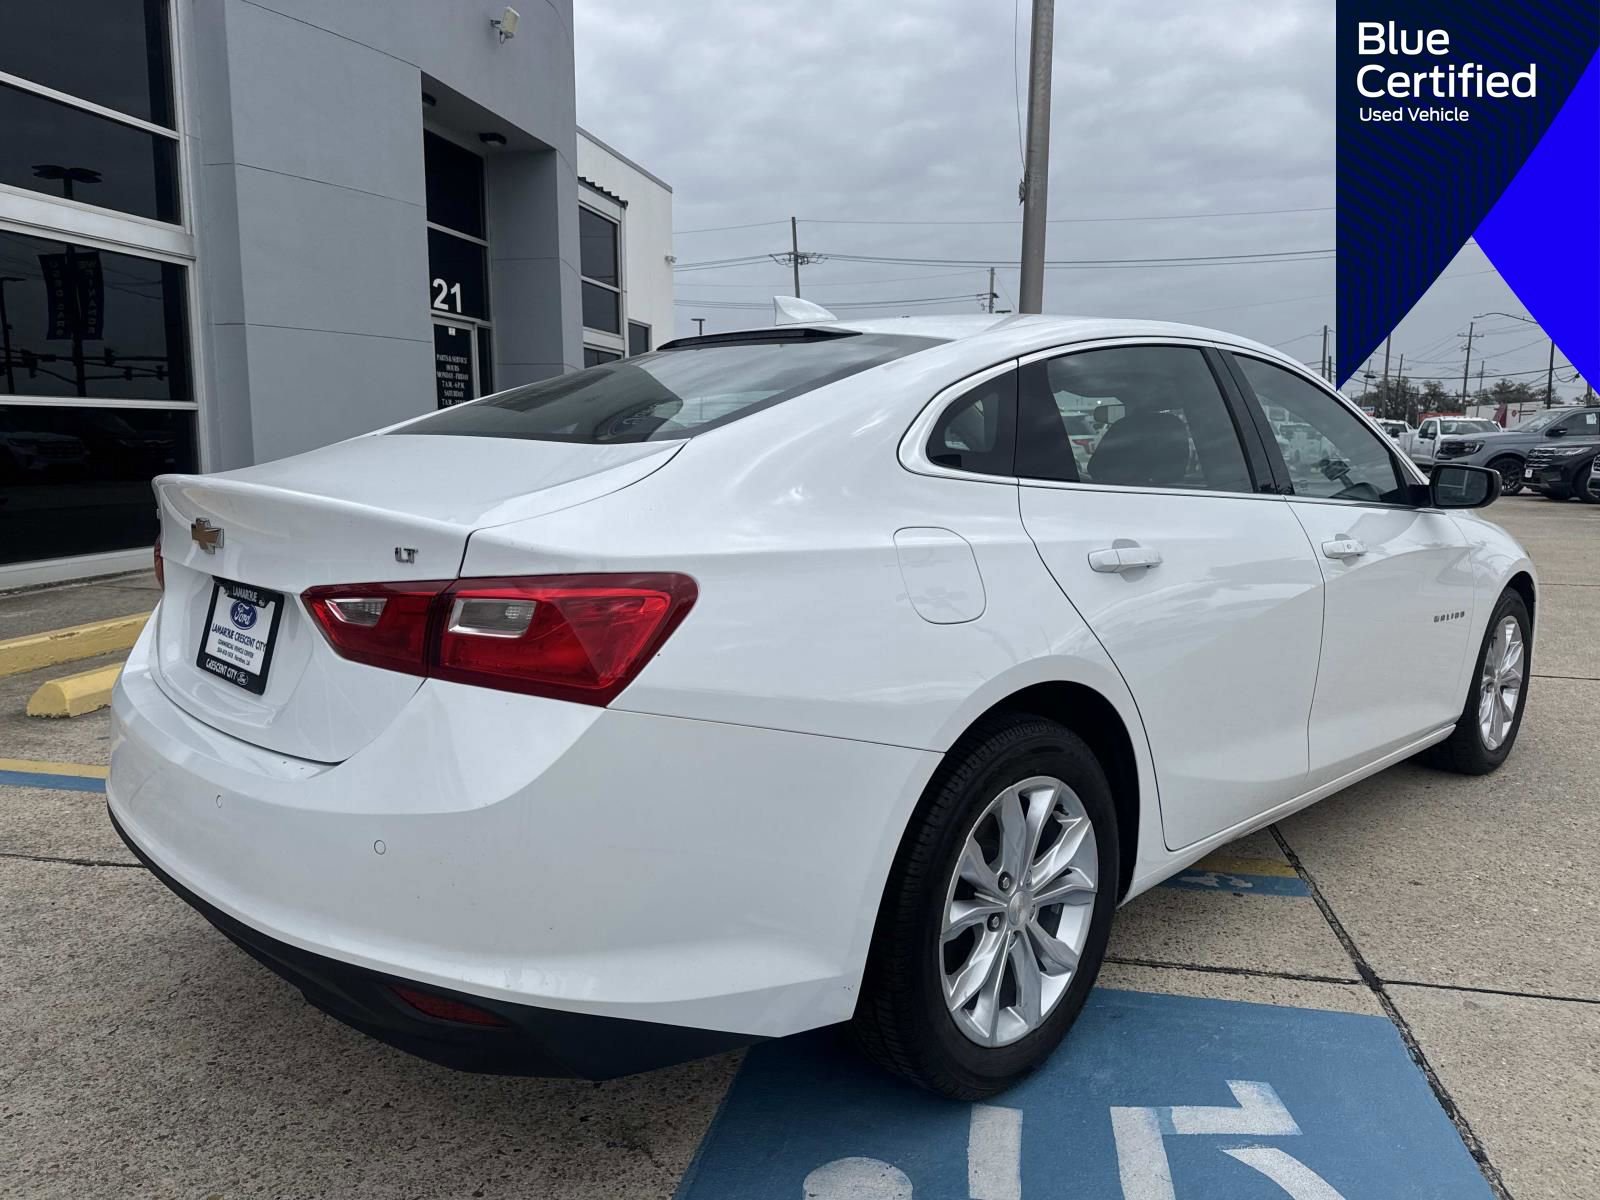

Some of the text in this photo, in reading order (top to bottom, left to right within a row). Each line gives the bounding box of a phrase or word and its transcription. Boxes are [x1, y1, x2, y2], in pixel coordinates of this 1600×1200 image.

[433, 278, 462, 313] 21
[395, 547, 418, 564] LT
[212, 622, 267, 652] LAMARQUE CRESCENT CITY
[205, 658, 227, 677] CRESCENT
[226, 667, 238, 681] CITY
